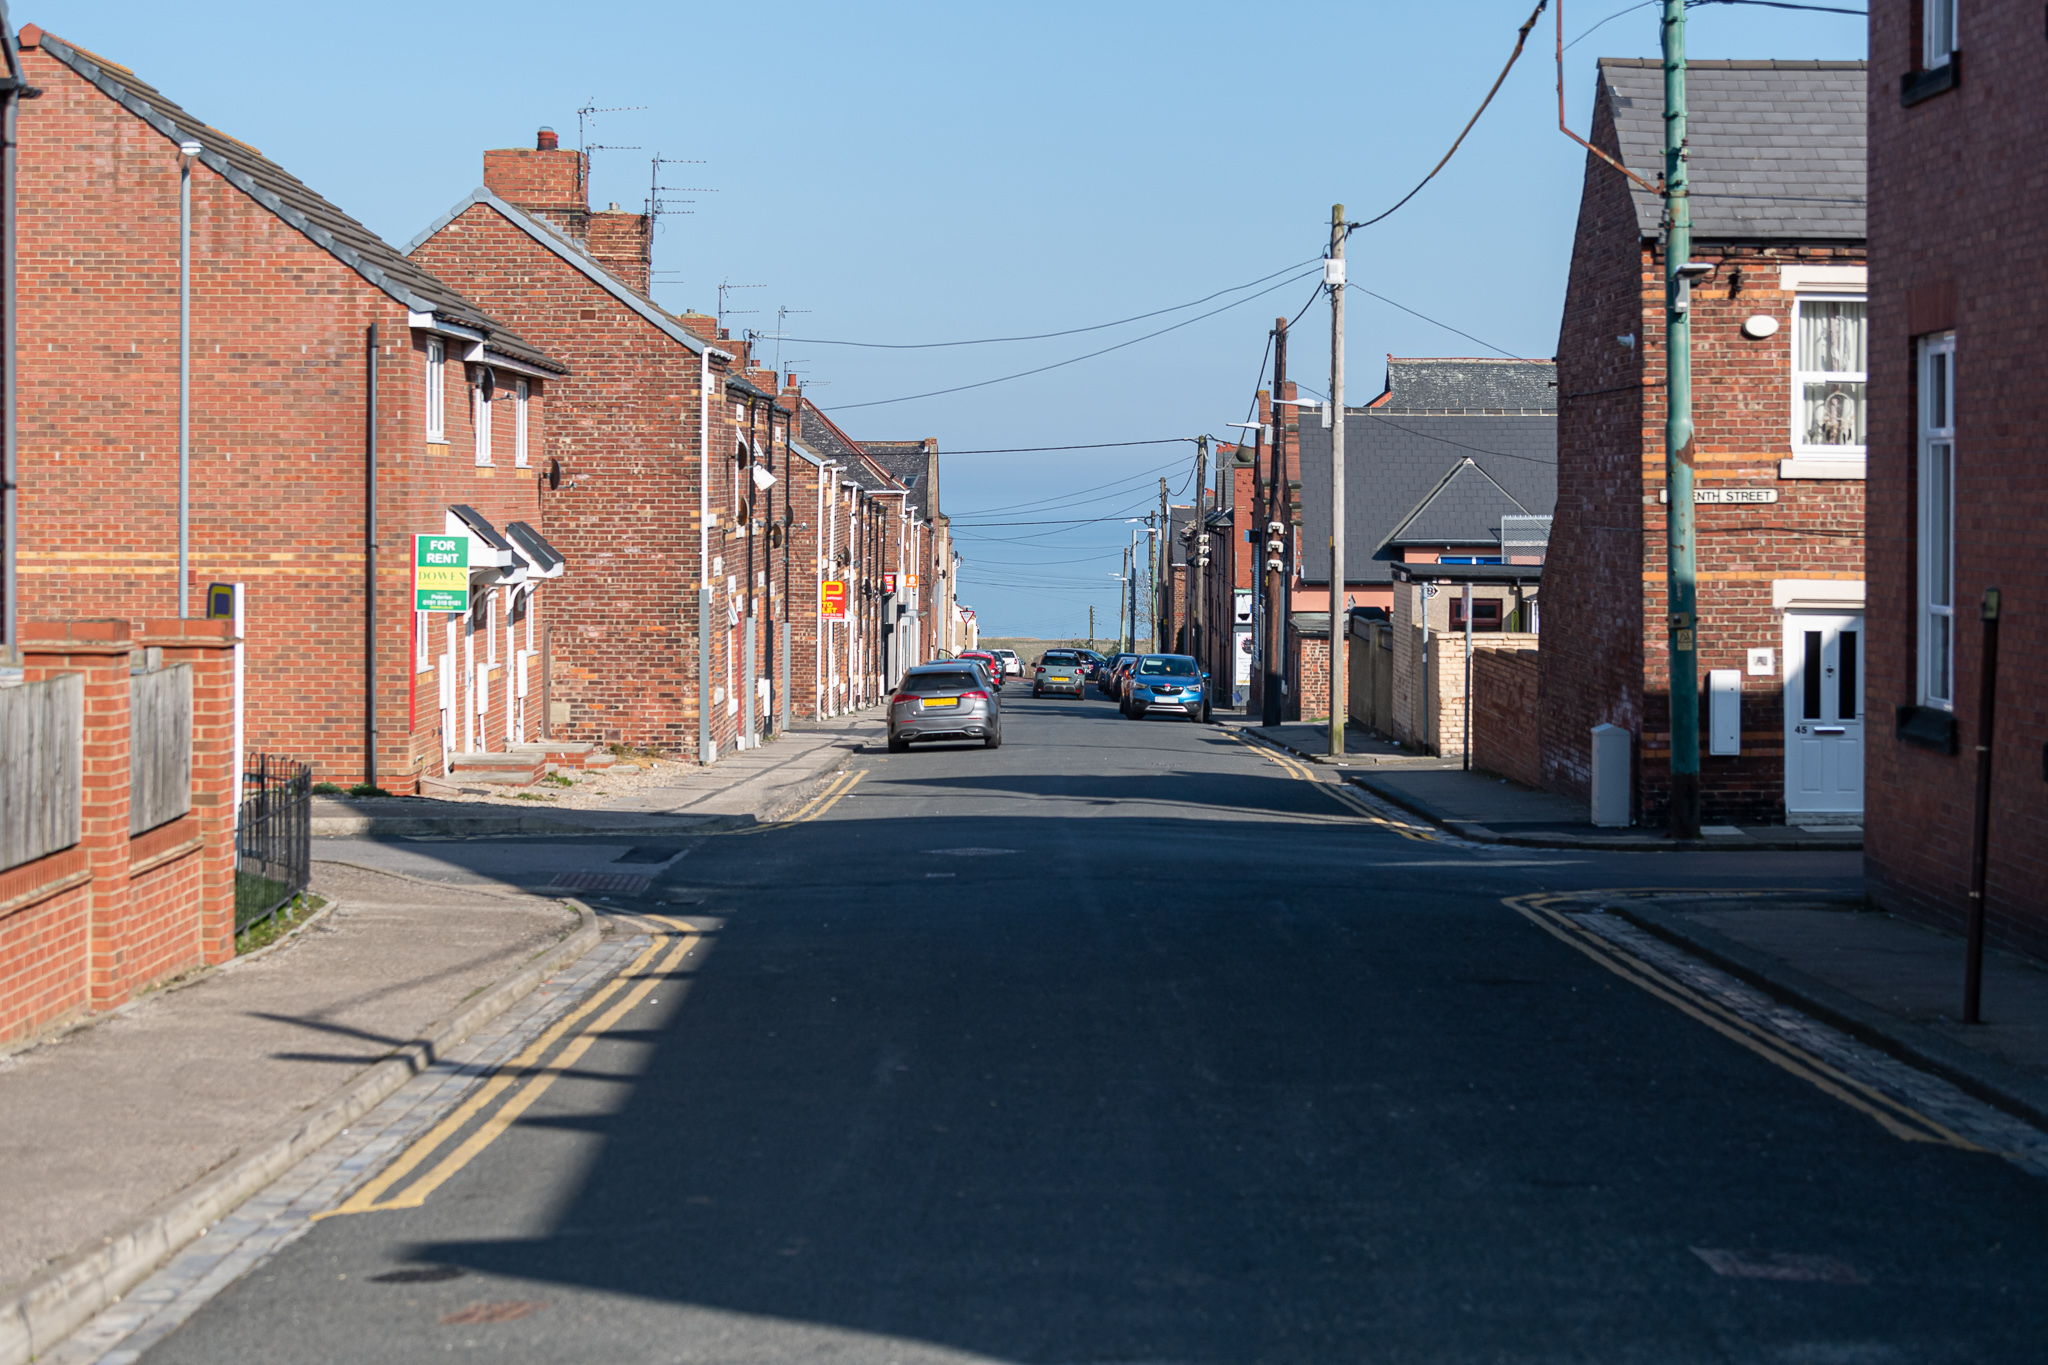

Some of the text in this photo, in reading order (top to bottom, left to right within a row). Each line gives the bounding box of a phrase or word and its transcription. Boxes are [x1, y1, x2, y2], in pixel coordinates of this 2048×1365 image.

[1726, 491, 1771, 501] STREET
[430, 540, 456, 551] FOR
[426, 553, 459, 564] RENT
[418, 571, 466, 580] DOWEN
[1794, 726, 1807, 734] 45
